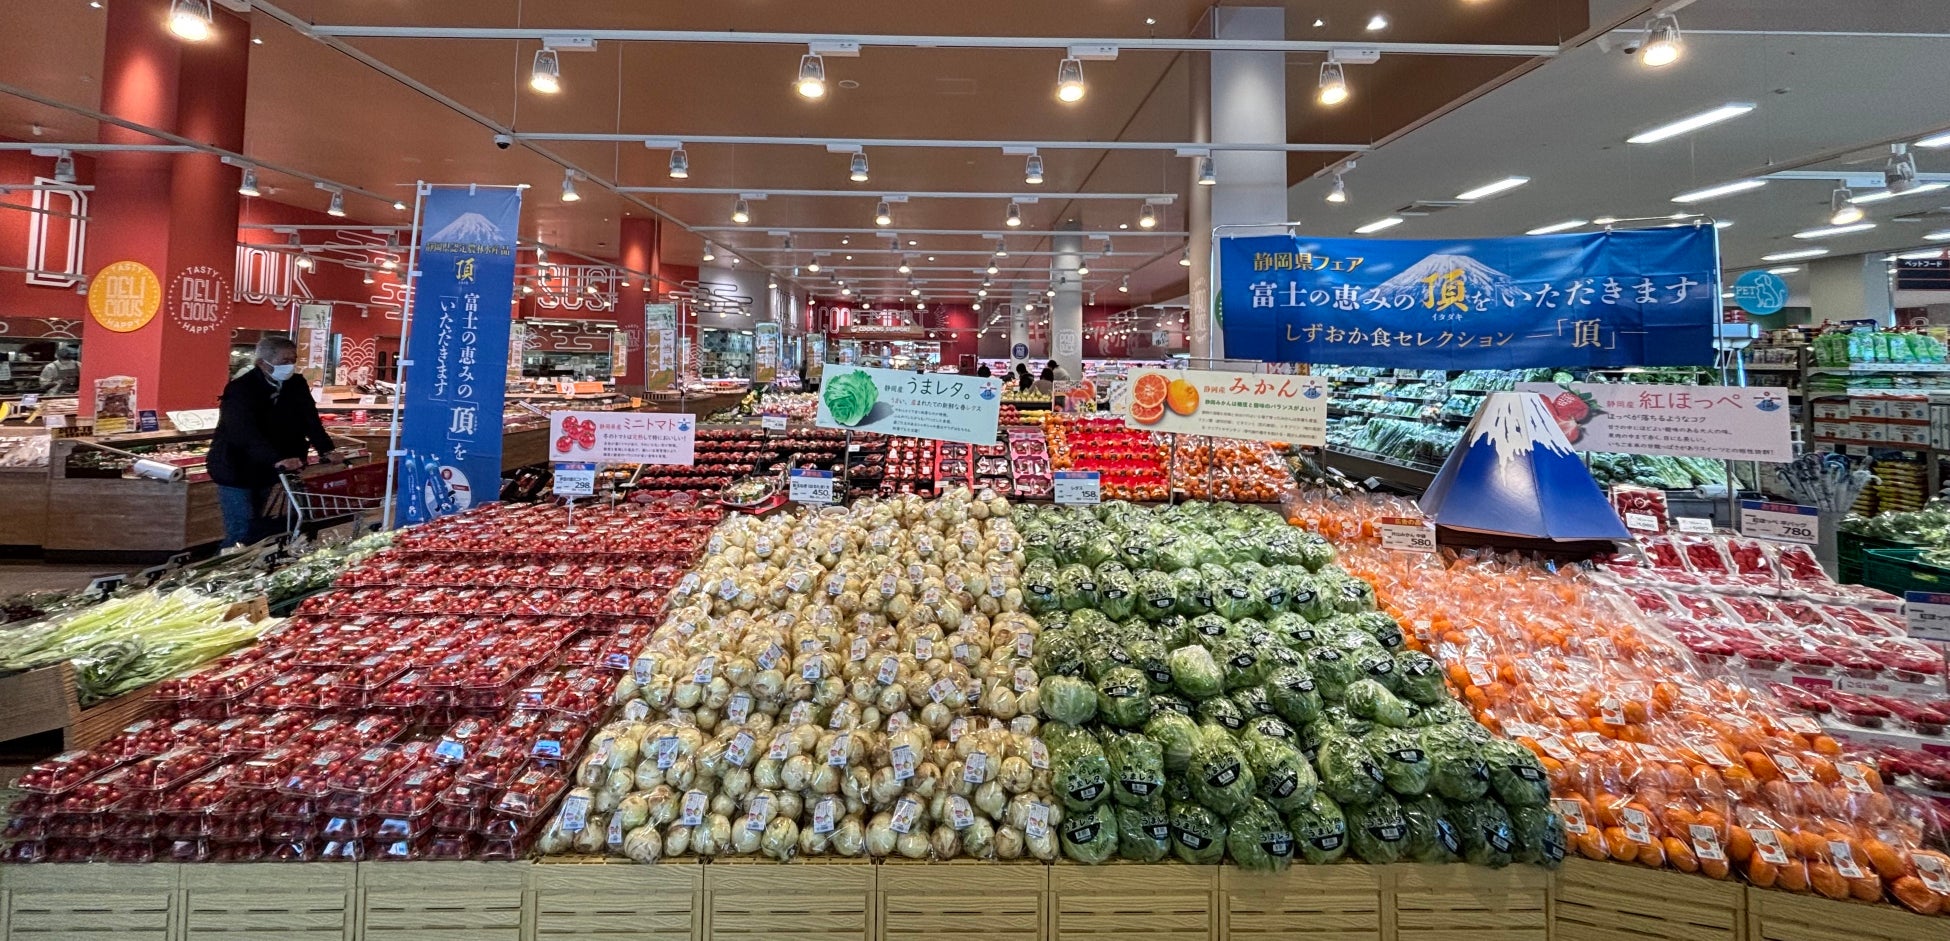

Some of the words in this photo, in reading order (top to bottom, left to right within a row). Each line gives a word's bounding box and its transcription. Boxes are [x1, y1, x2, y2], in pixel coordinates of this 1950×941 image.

[112, 263, 143, 273] TASTY
[1254, 252, 1364, 272] 静岡県フェア
[1905, 259, 1943, 269] ペットフード
[187, 266, 219, 277] TASTY
[105, 276, 146, 299] DELI
[182, 277, 220, 303] DELI
[1736, 286, 1756, 296] PET
[104, 299, 144, 318] CIOUS
[181, 302, 218, 321] CIOUS
[107, 319, 140, 328] HAPPY
[182, 322, 215, 334] HAPPY
[1285, 323, 1514, 349] しずおか食セレクション
[884, 385, 903, 393] 静岡産
[1204, 385, 1226, 394] 静岡産
[1229, 377, 1298, 398] みかん
[1606, 400, 1634, 408] 静岡産
[1639, 390, 1743, 410] 紅ほっぺ
[623, 417, 676, 432] ミニトマト
[1782, 526, 1811, 537] 780
[1411, 538, 1431, 546] 580
